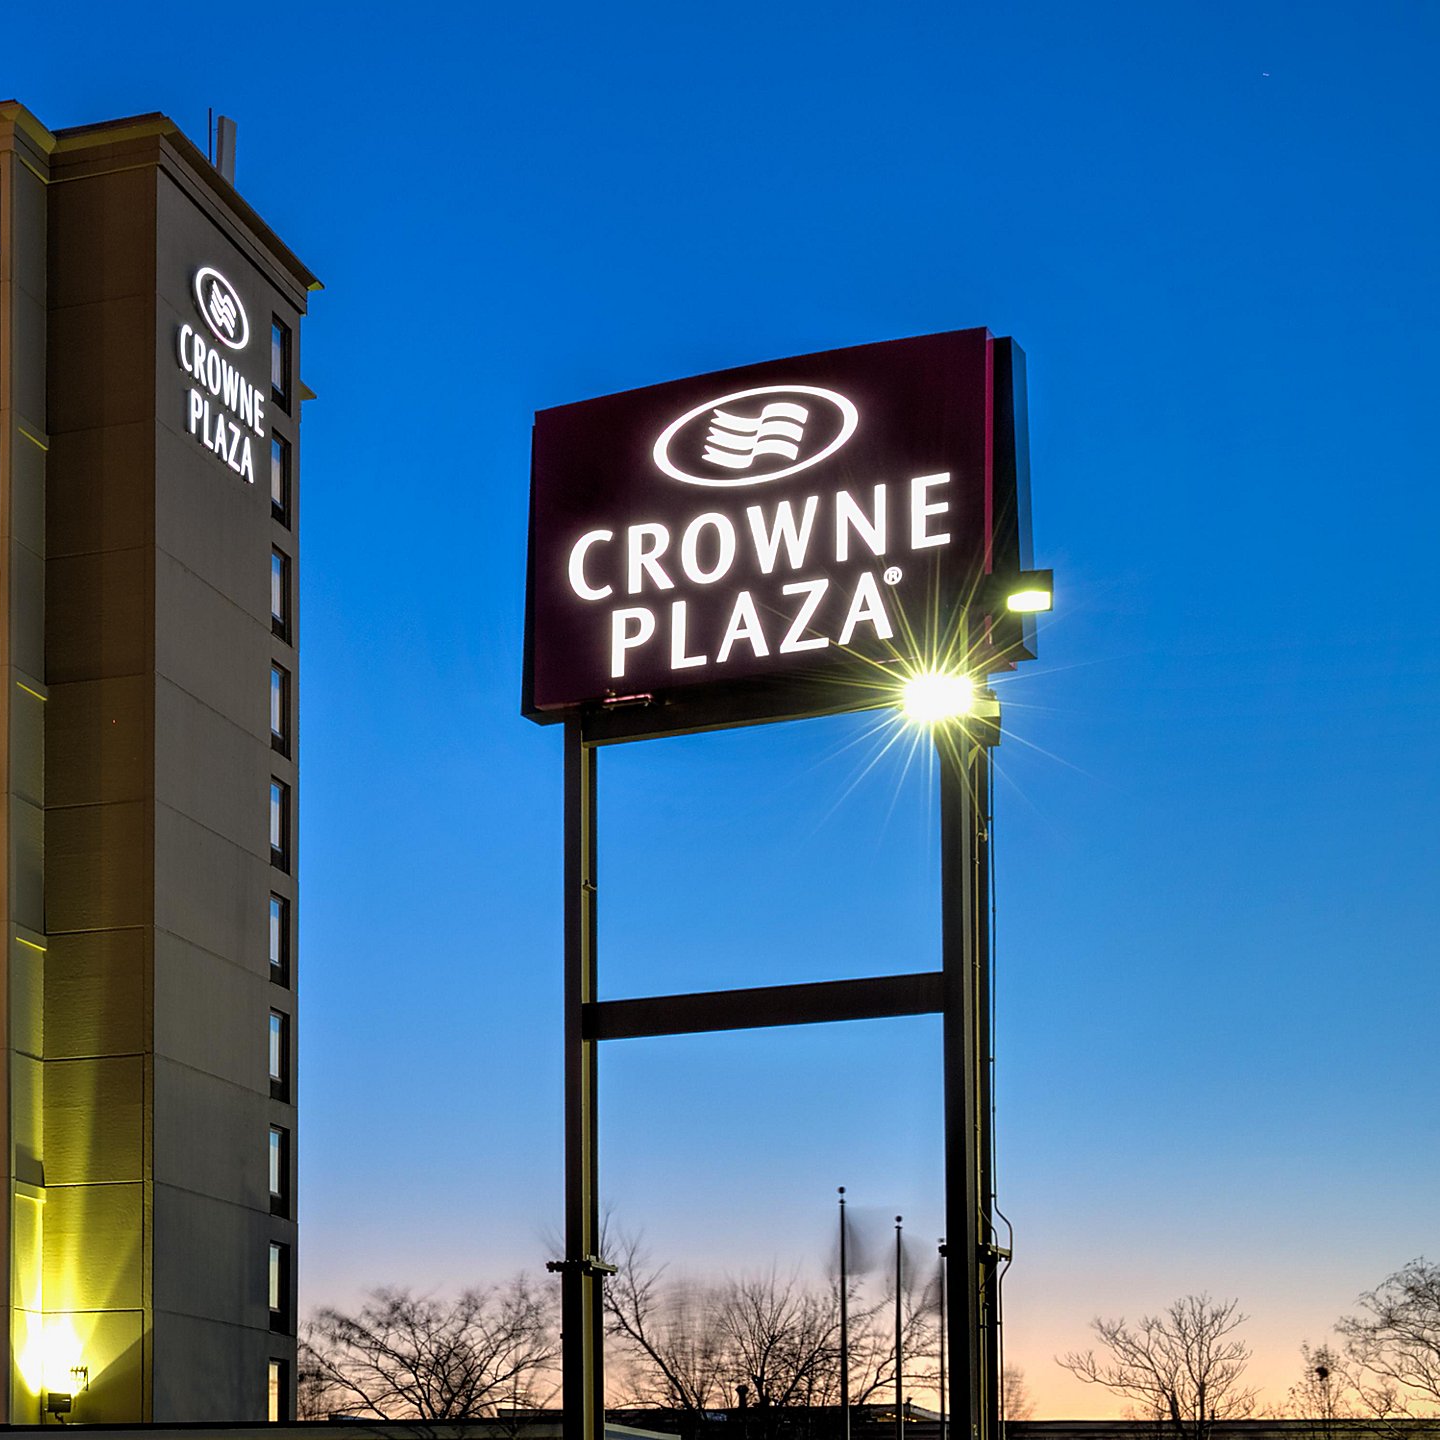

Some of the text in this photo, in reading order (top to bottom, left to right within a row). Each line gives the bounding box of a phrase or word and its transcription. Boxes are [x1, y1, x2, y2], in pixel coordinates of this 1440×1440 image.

[180, 324, 265, 438] CROWNE
[190, 388, 254, 484] PLAZA
[568, 472, 951, 601] CROWNE
